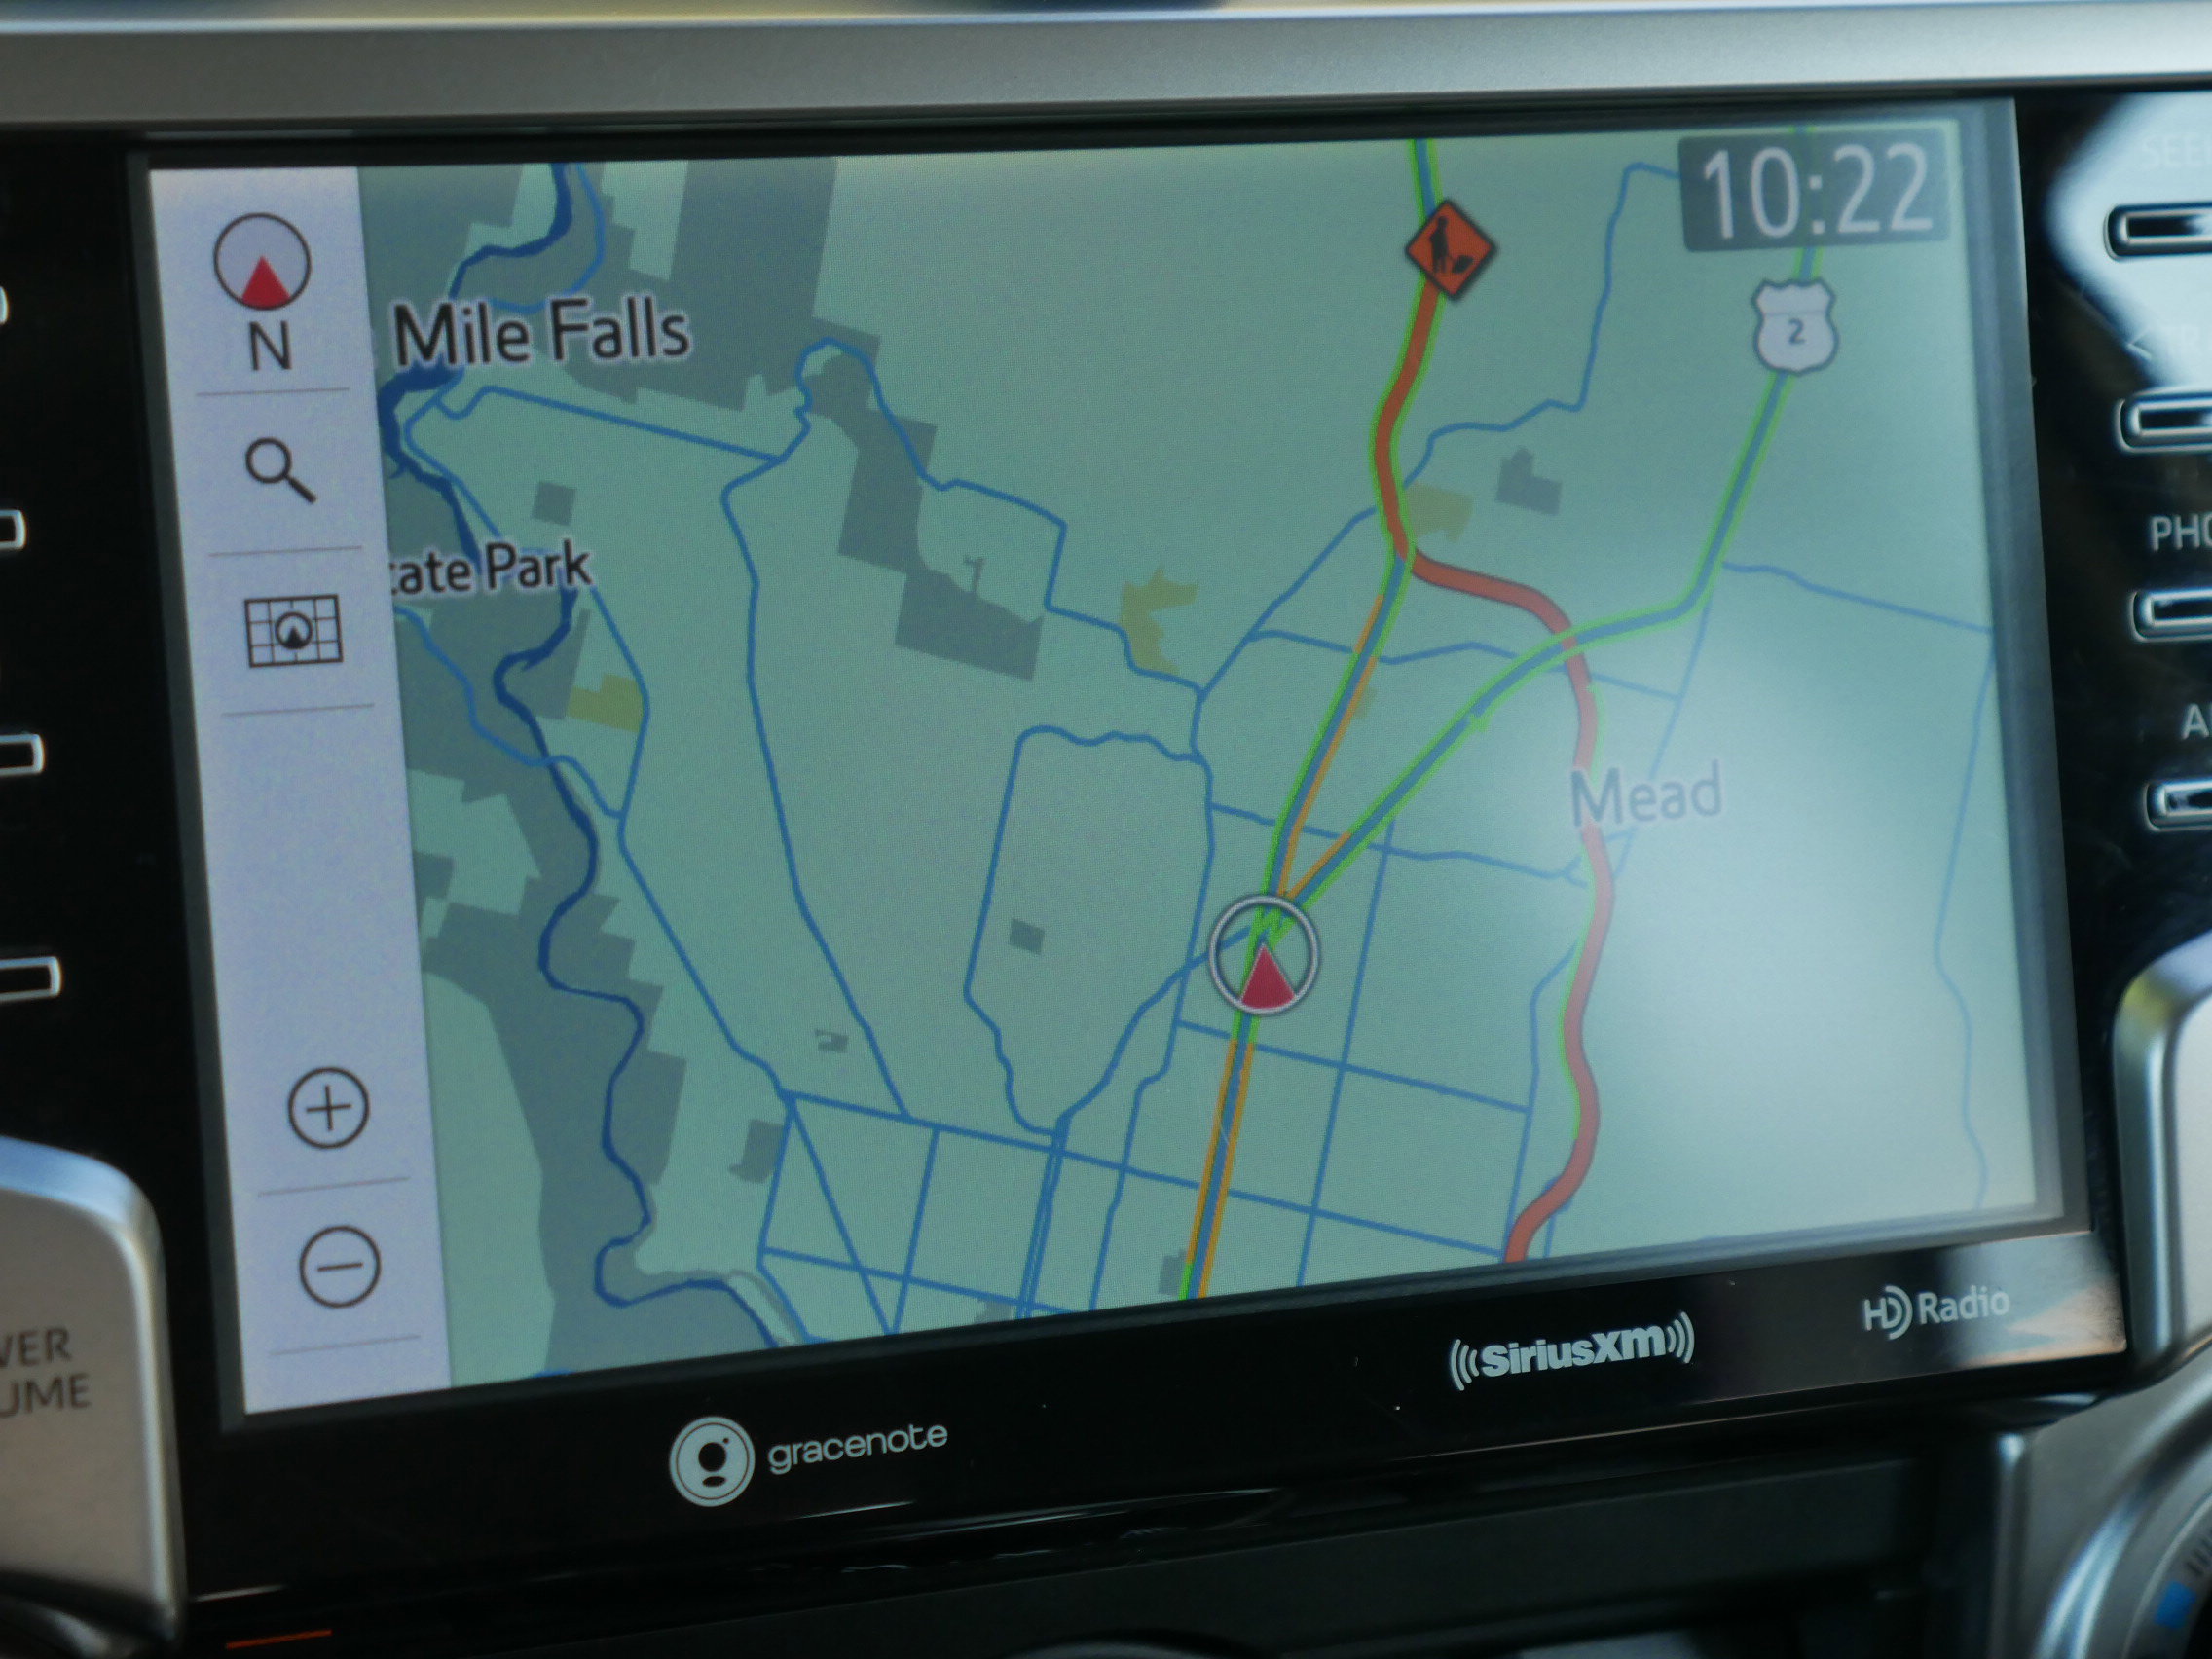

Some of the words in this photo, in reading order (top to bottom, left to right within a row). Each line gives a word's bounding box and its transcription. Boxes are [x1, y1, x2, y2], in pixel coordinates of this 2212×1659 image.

[1703, 142, 1934, 239] 10:22
[247, 320, 292, 372] N
[392, 300, 531, 367] Mile
[549, 296, 690, 361] Falls
[1787, 317, 1806, 346] 2
[2150, 513, 2212, 551] PH
[388, 551, 471, 597] ate
[485, 539, 592, 590] Park
[1570, 758, 1721, 827] Mead
[1863, 1285, 1913, 1340] HD
[1918, 1284, 2011, 1325] Radio
[767, 1423, 948, 1475] gracenote
